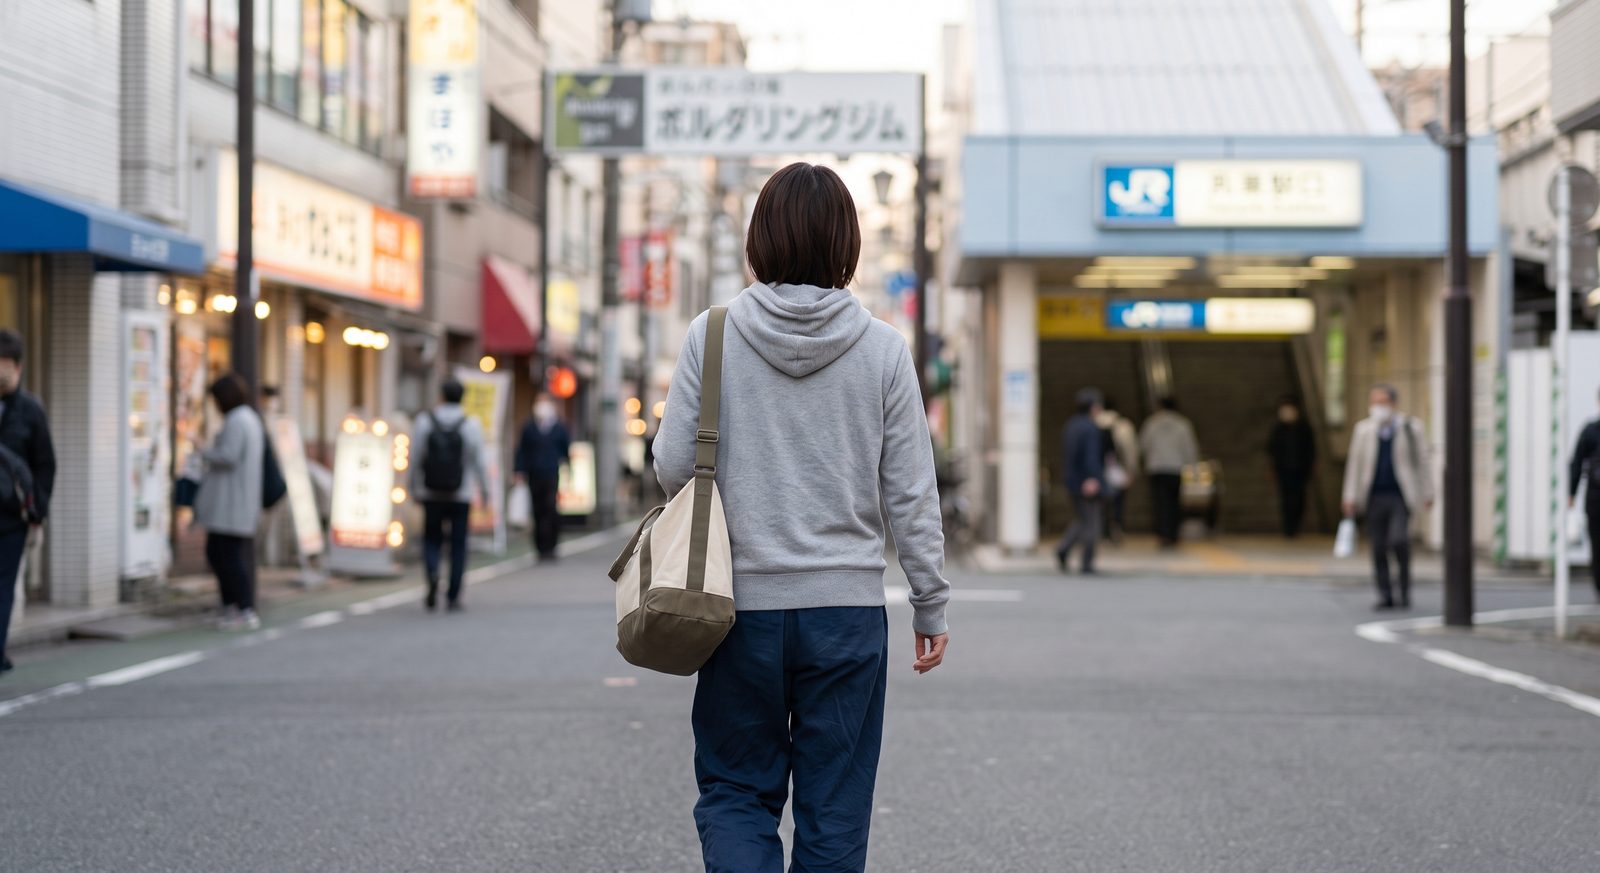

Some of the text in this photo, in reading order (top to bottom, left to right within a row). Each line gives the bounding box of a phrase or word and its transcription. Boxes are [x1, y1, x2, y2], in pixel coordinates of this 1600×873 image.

[656, 99, 905, 141] ボルダリングジム
[1109, 169, 1170, 207] JR
[1121, 301, 1160, 328] JR
